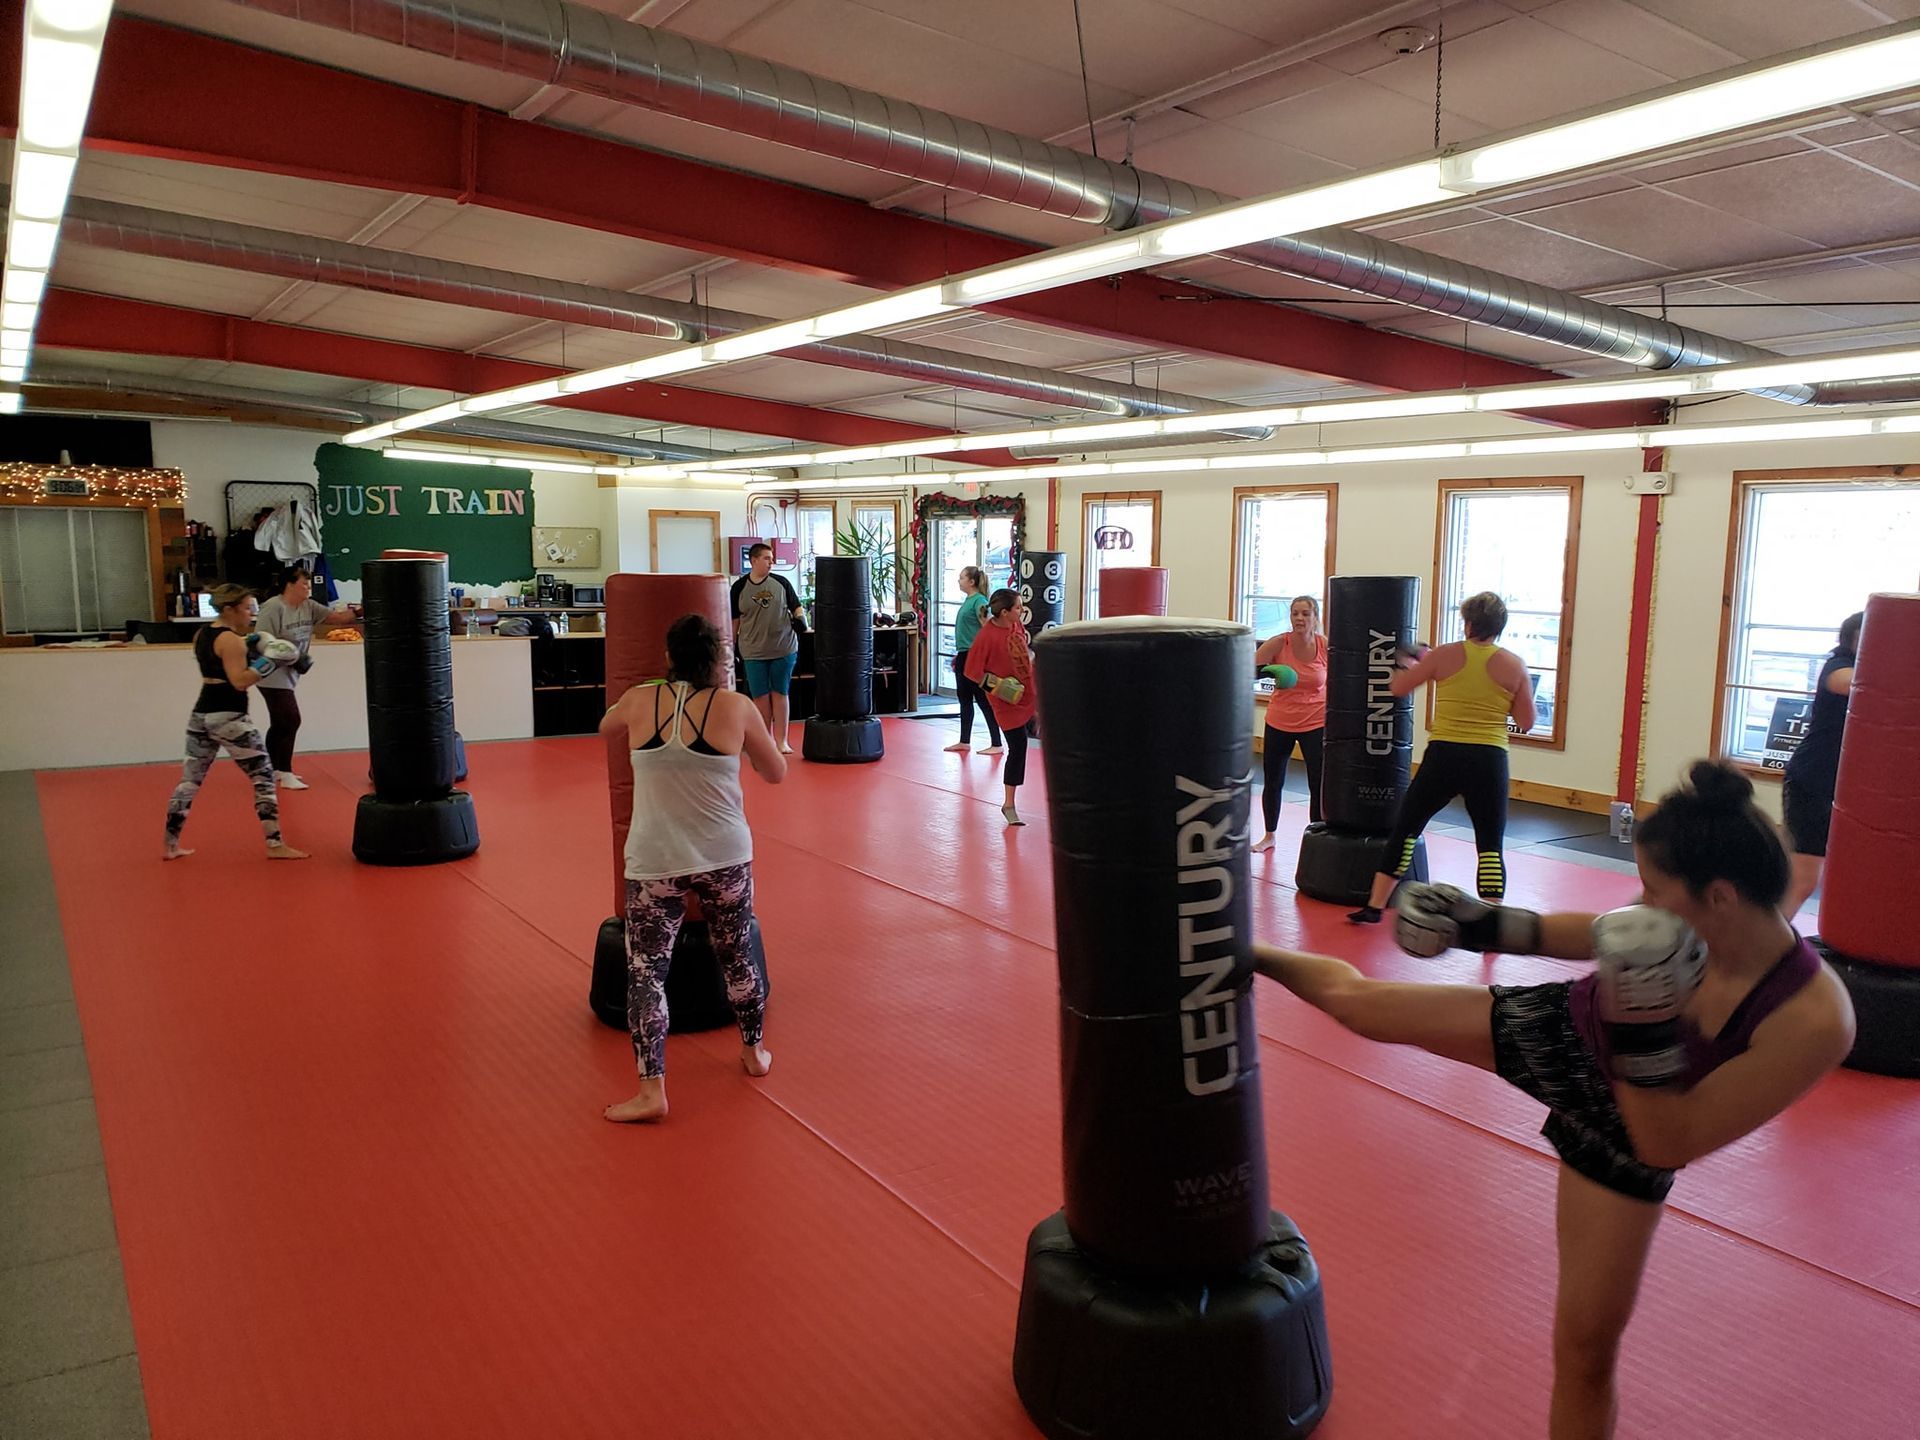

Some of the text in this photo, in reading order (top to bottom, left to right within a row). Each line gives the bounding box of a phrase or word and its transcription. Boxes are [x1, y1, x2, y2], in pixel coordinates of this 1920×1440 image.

[326, 485, 525, 516] JUST TRAIN
[1049, 563, 1058, 576] 3
[1022, 588, 1057, 601] 4 6
[1358, 785, 1395, 795] WAVE
[1175, 775, 1238, 1096] CENTURY
